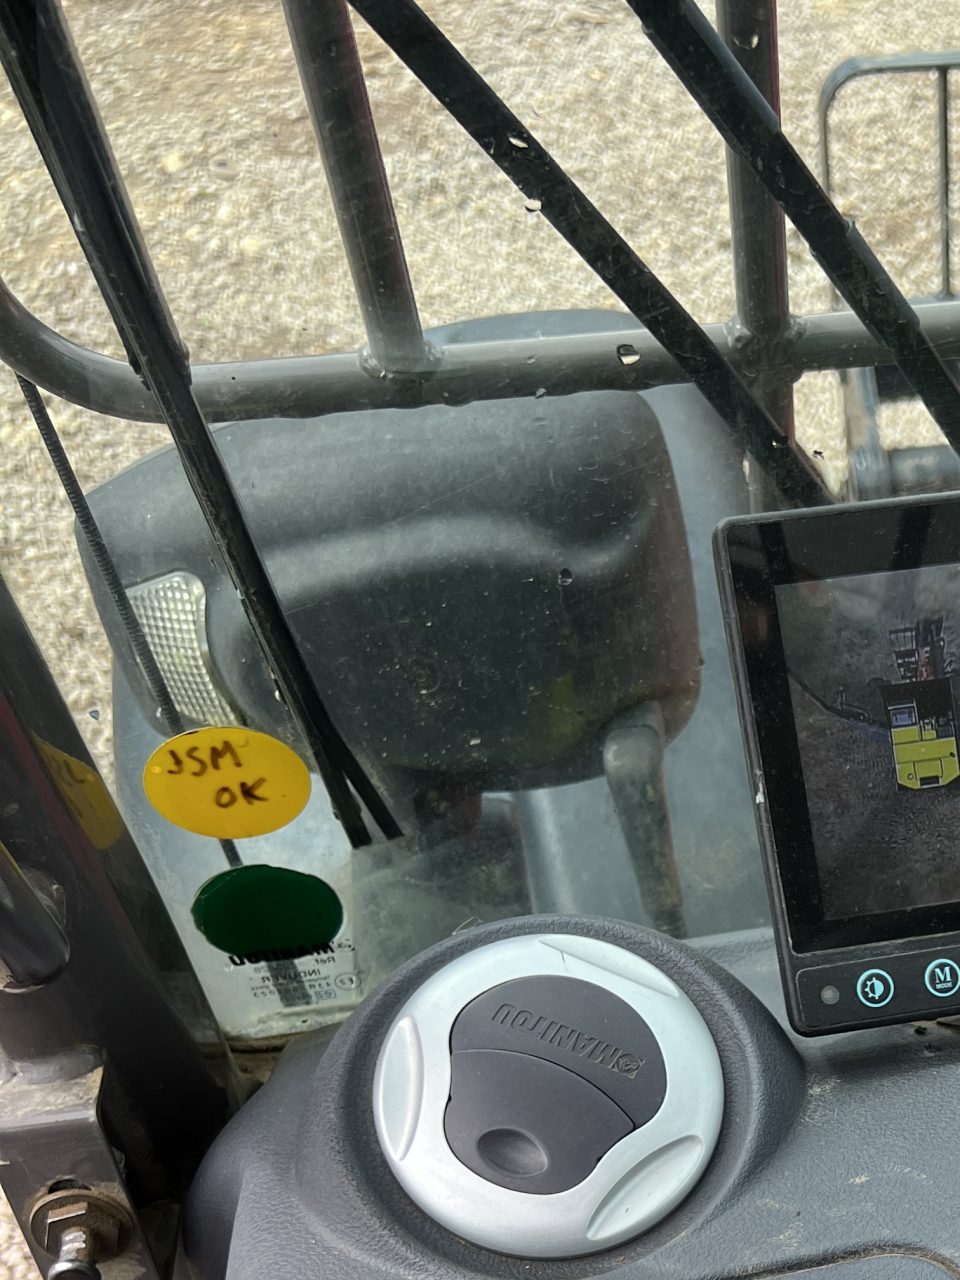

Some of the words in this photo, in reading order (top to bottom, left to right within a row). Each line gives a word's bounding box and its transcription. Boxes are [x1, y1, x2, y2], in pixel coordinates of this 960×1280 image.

[167, 740, 242, 776] JSM
[215, 777, 269, 808] OK
[491, 1003, 619, 1072] MANITOU
